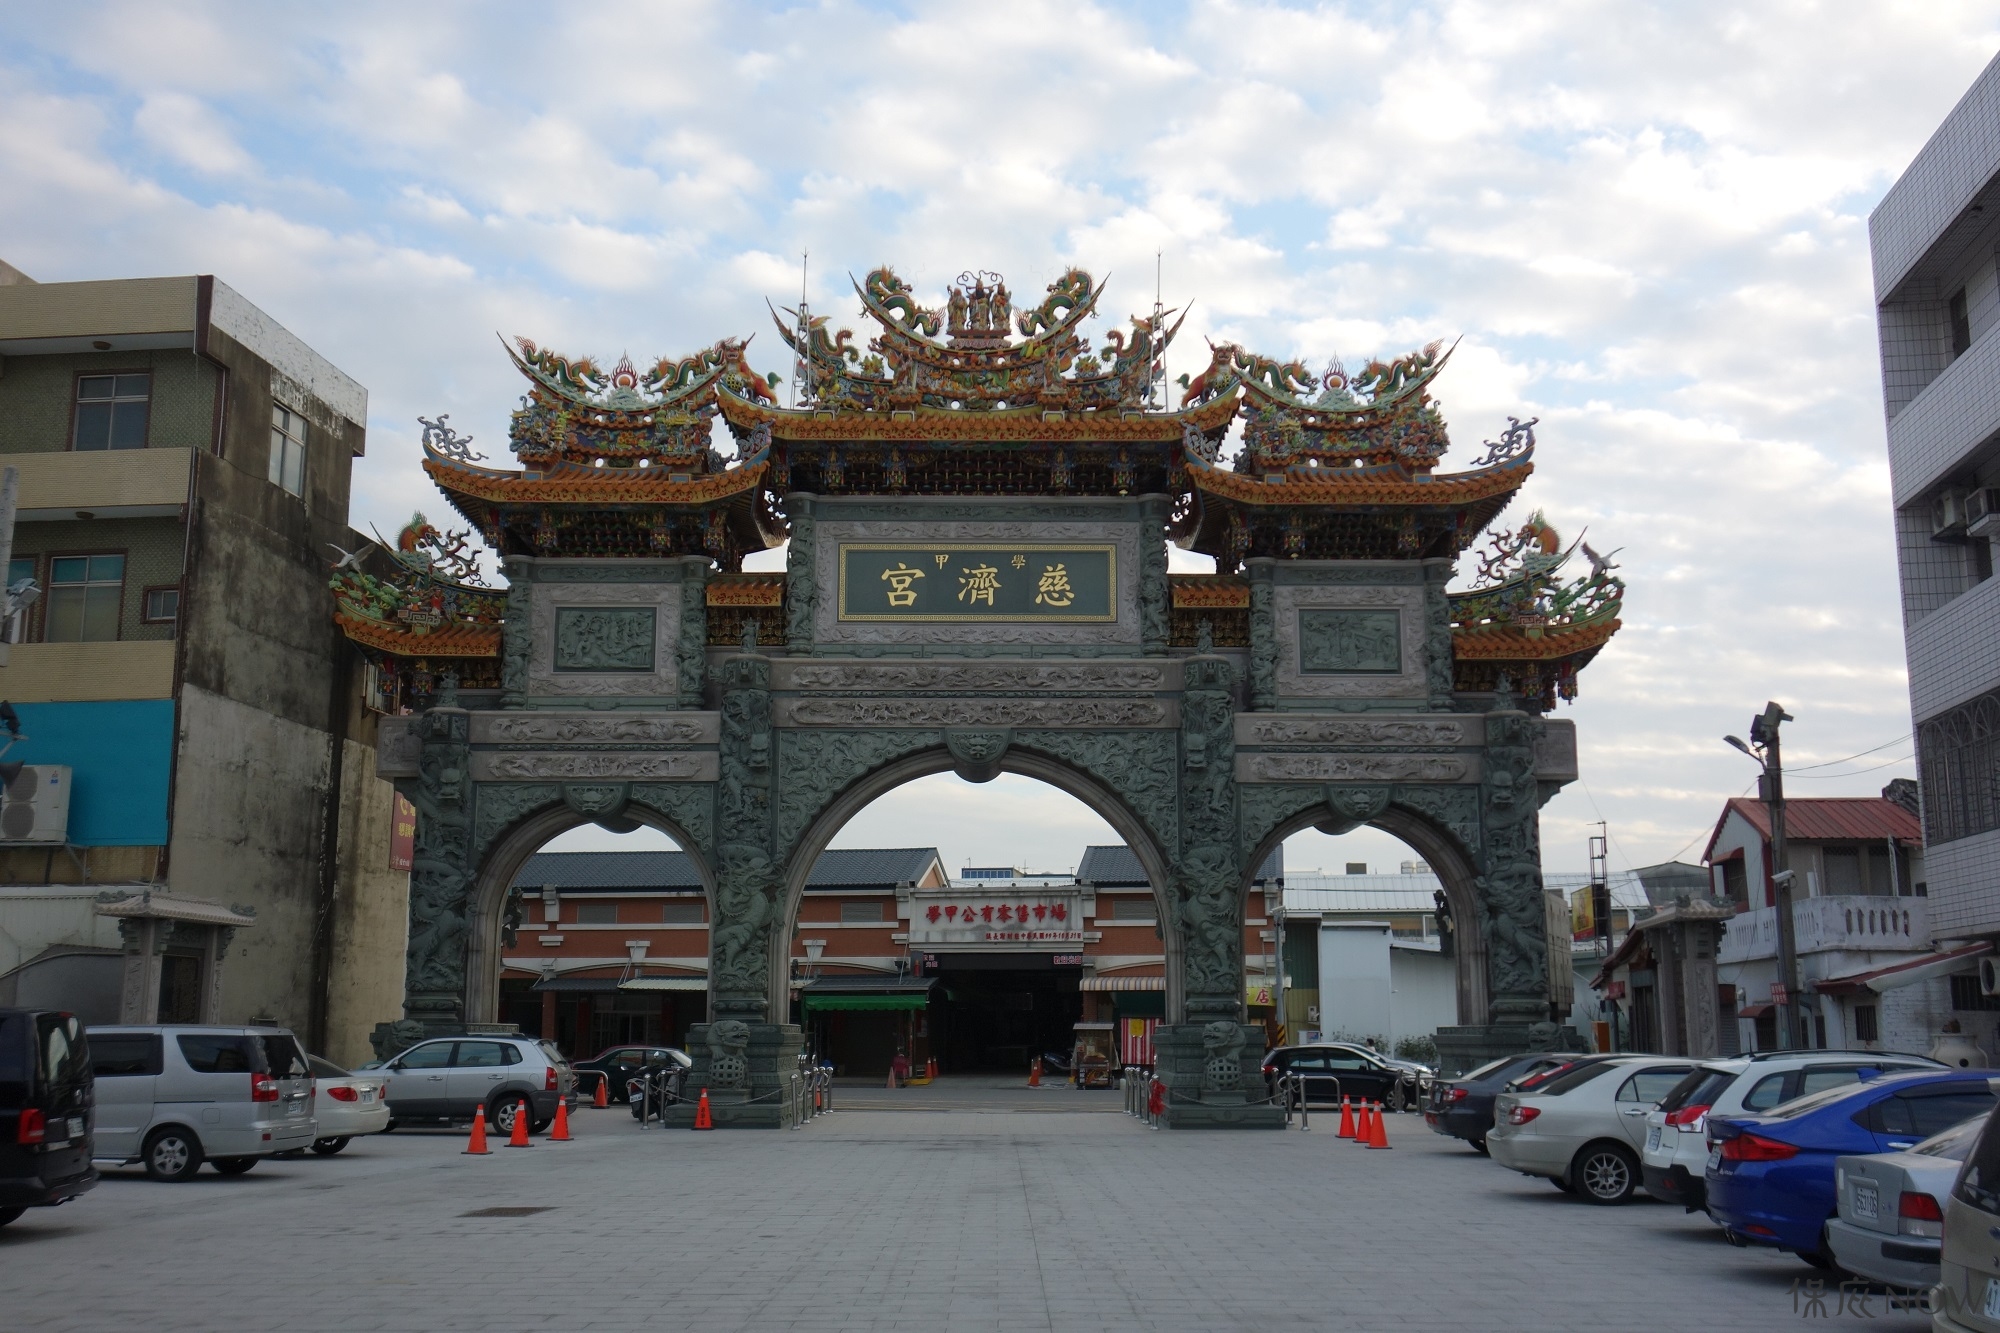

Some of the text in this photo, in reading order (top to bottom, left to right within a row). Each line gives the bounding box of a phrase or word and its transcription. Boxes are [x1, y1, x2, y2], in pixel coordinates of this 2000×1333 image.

[925, 903, 1068, 924] 學甲公有零售市場
